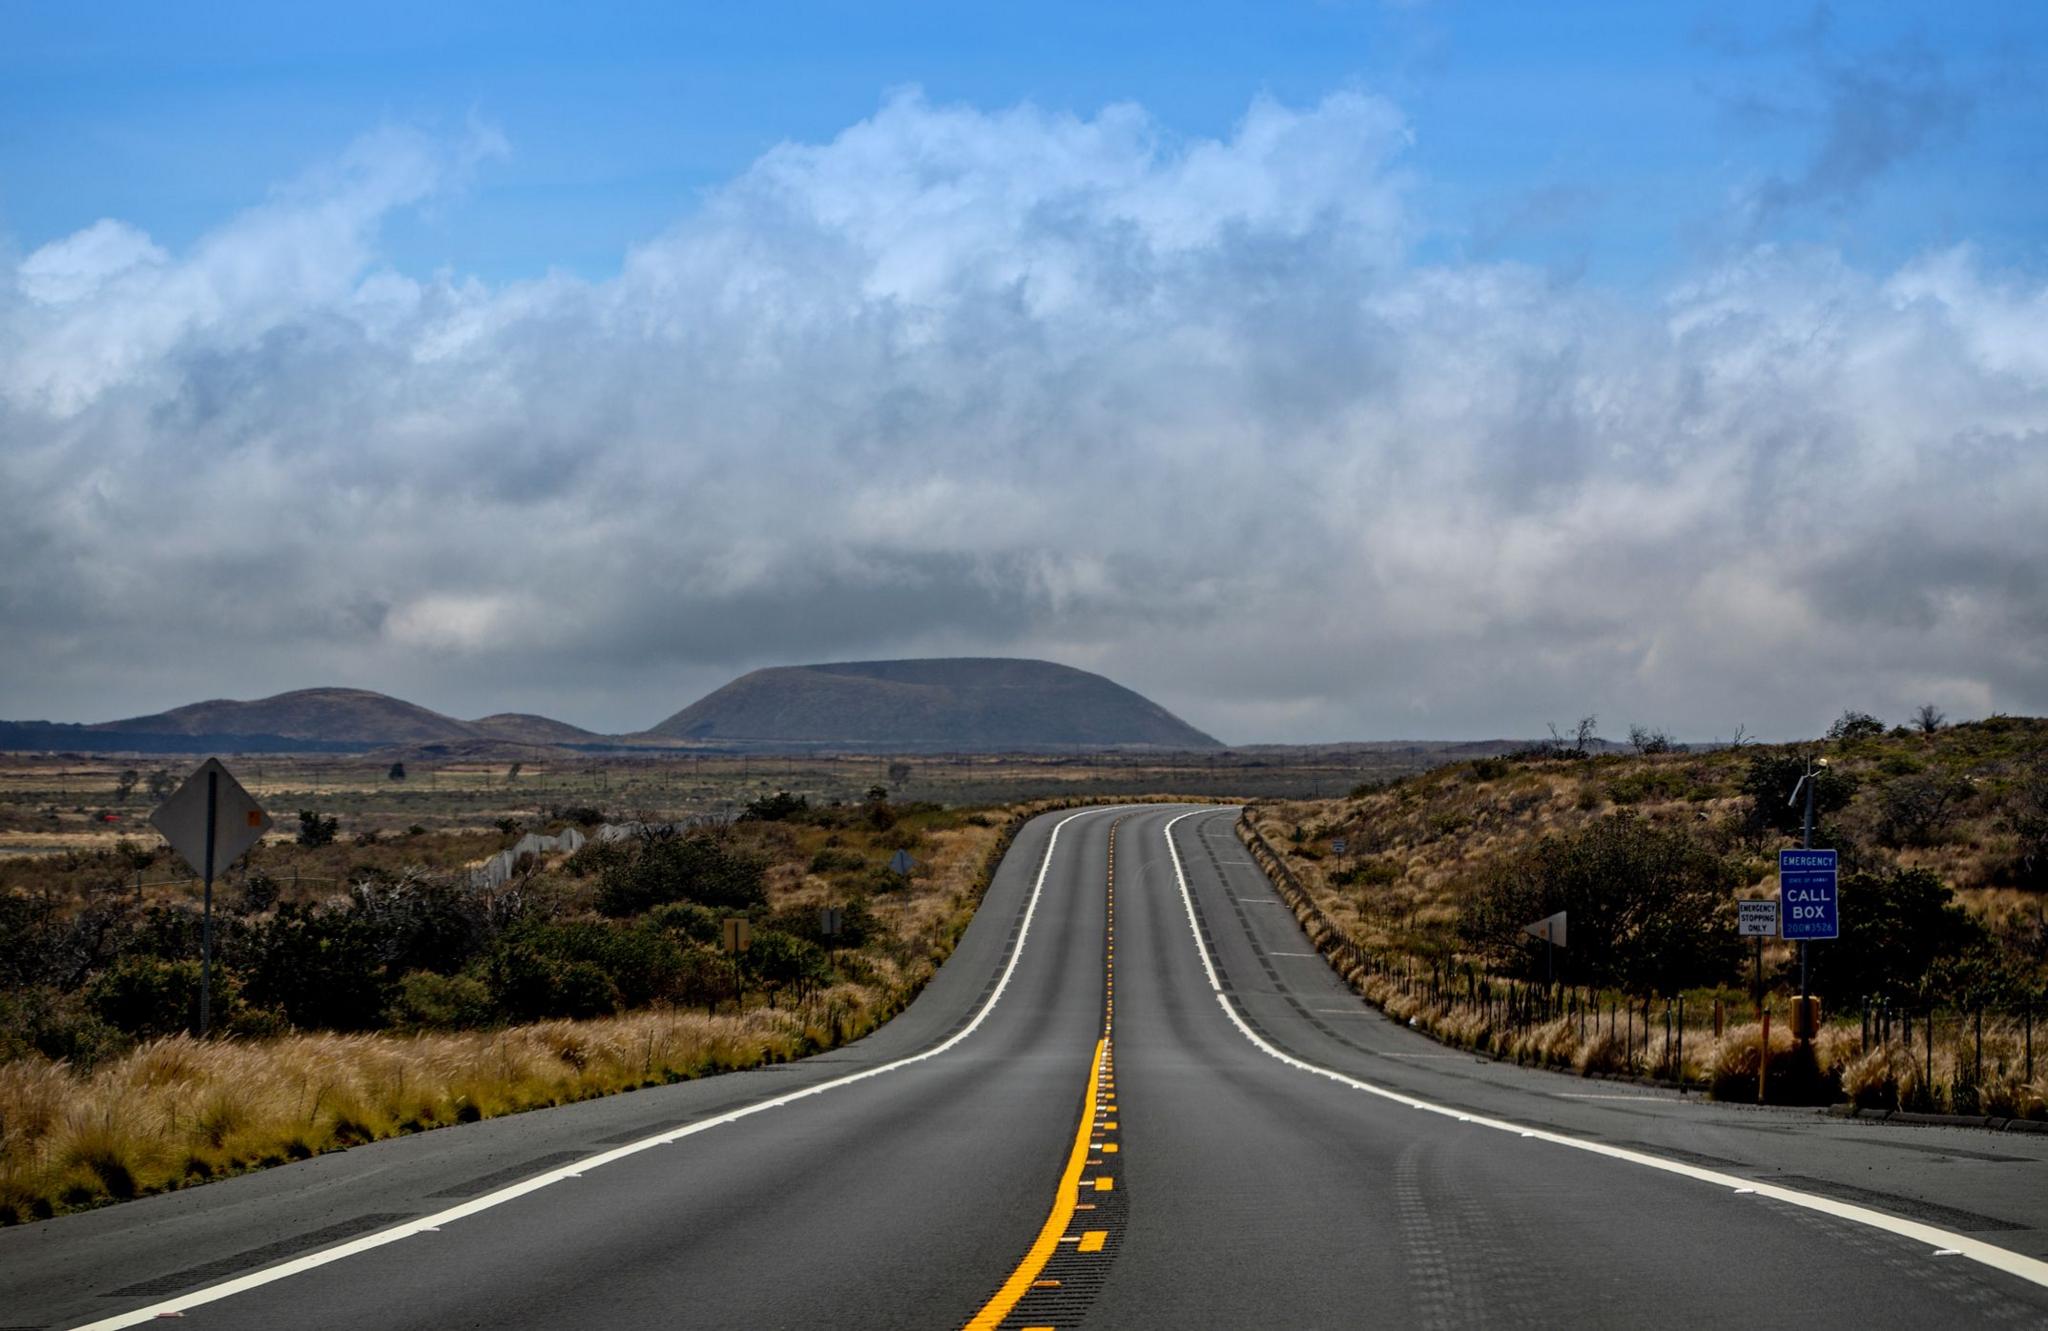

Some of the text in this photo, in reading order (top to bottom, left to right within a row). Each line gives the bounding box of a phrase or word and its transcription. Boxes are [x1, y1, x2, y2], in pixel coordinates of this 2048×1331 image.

[1783, 856, 1834, 866] EMERGENCY
[1787, 888, 1831, 902] CALL
[1740, 904, 1775, 912] EMERGENCY
[1792, 905, 1825, 919] BOX
[1741, 914, 1775, 922] STOPPING
[1748, 924, 1767, 932] ONLY
